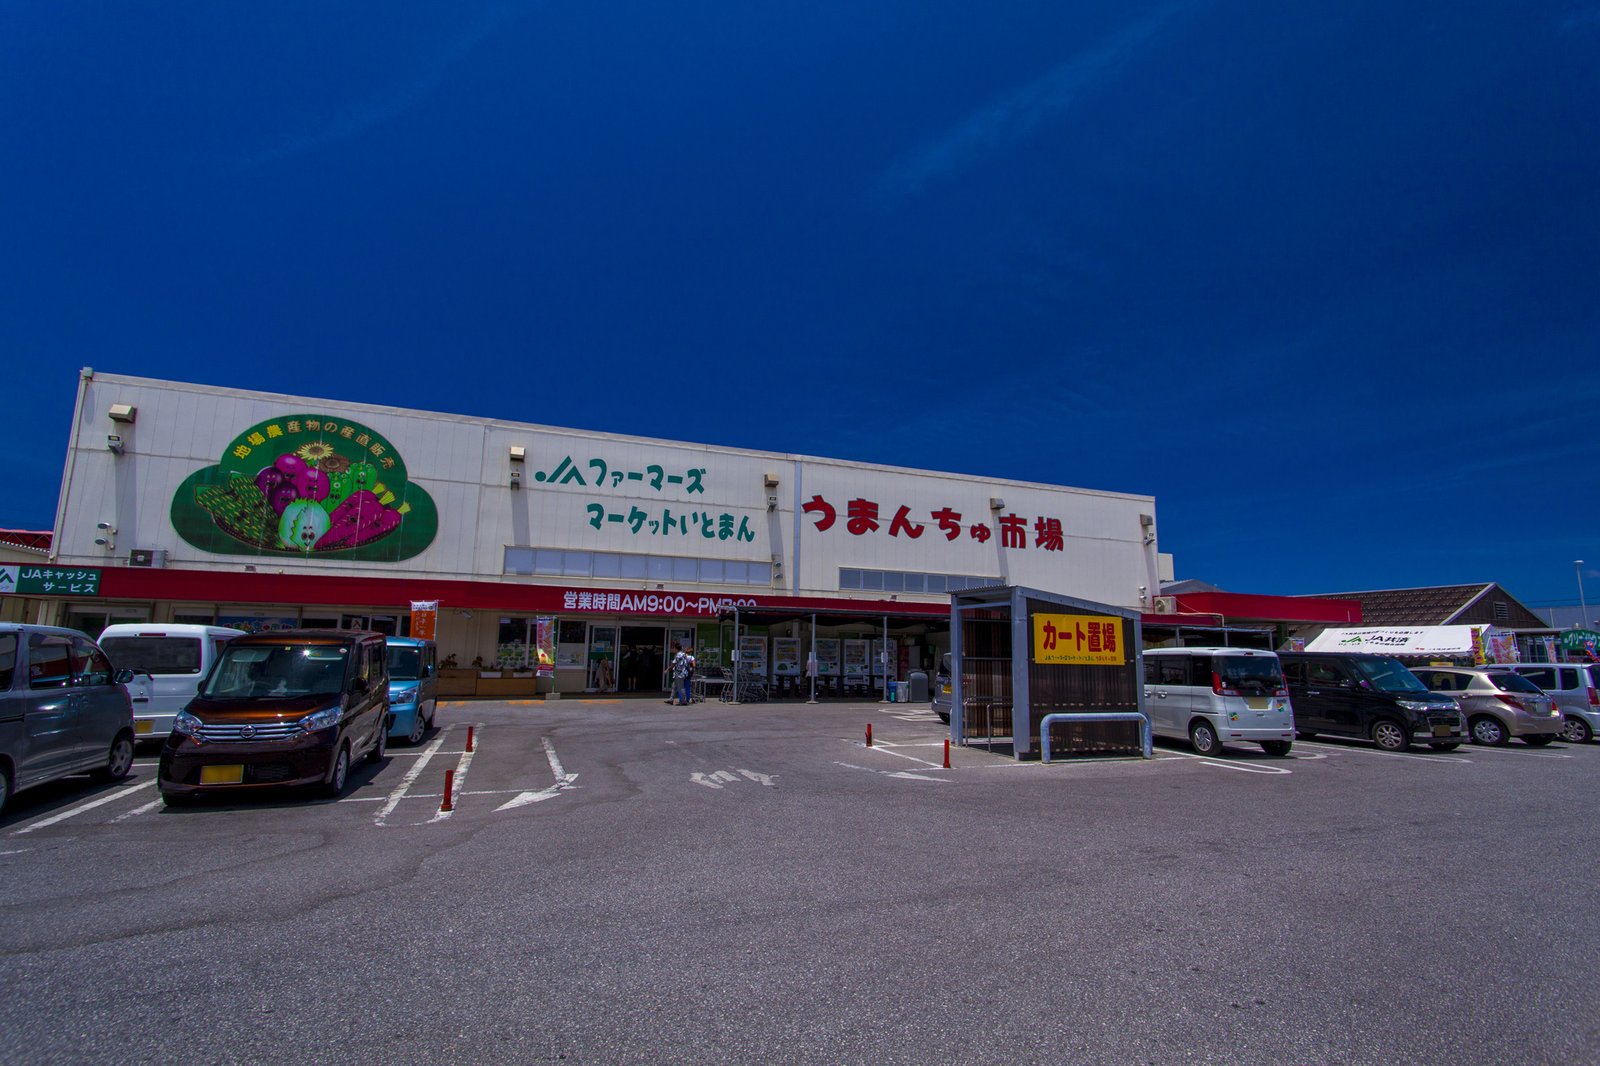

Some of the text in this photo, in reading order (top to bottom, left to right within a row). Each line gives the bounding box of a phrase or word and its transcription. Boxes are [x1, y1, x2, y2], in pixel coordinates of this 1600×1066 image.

[233, 419, 395, 469] 地場農産物の産直販売
[586, 503, 755, 542] マーケットいとまん
[801, 494, 1064, 552] うまんちゅ市場
[21, 569, 97, 580] JAキャッシュ
[43, 582, 95, 593] サービス
[1043, 620, 1116, 653] カート置場
